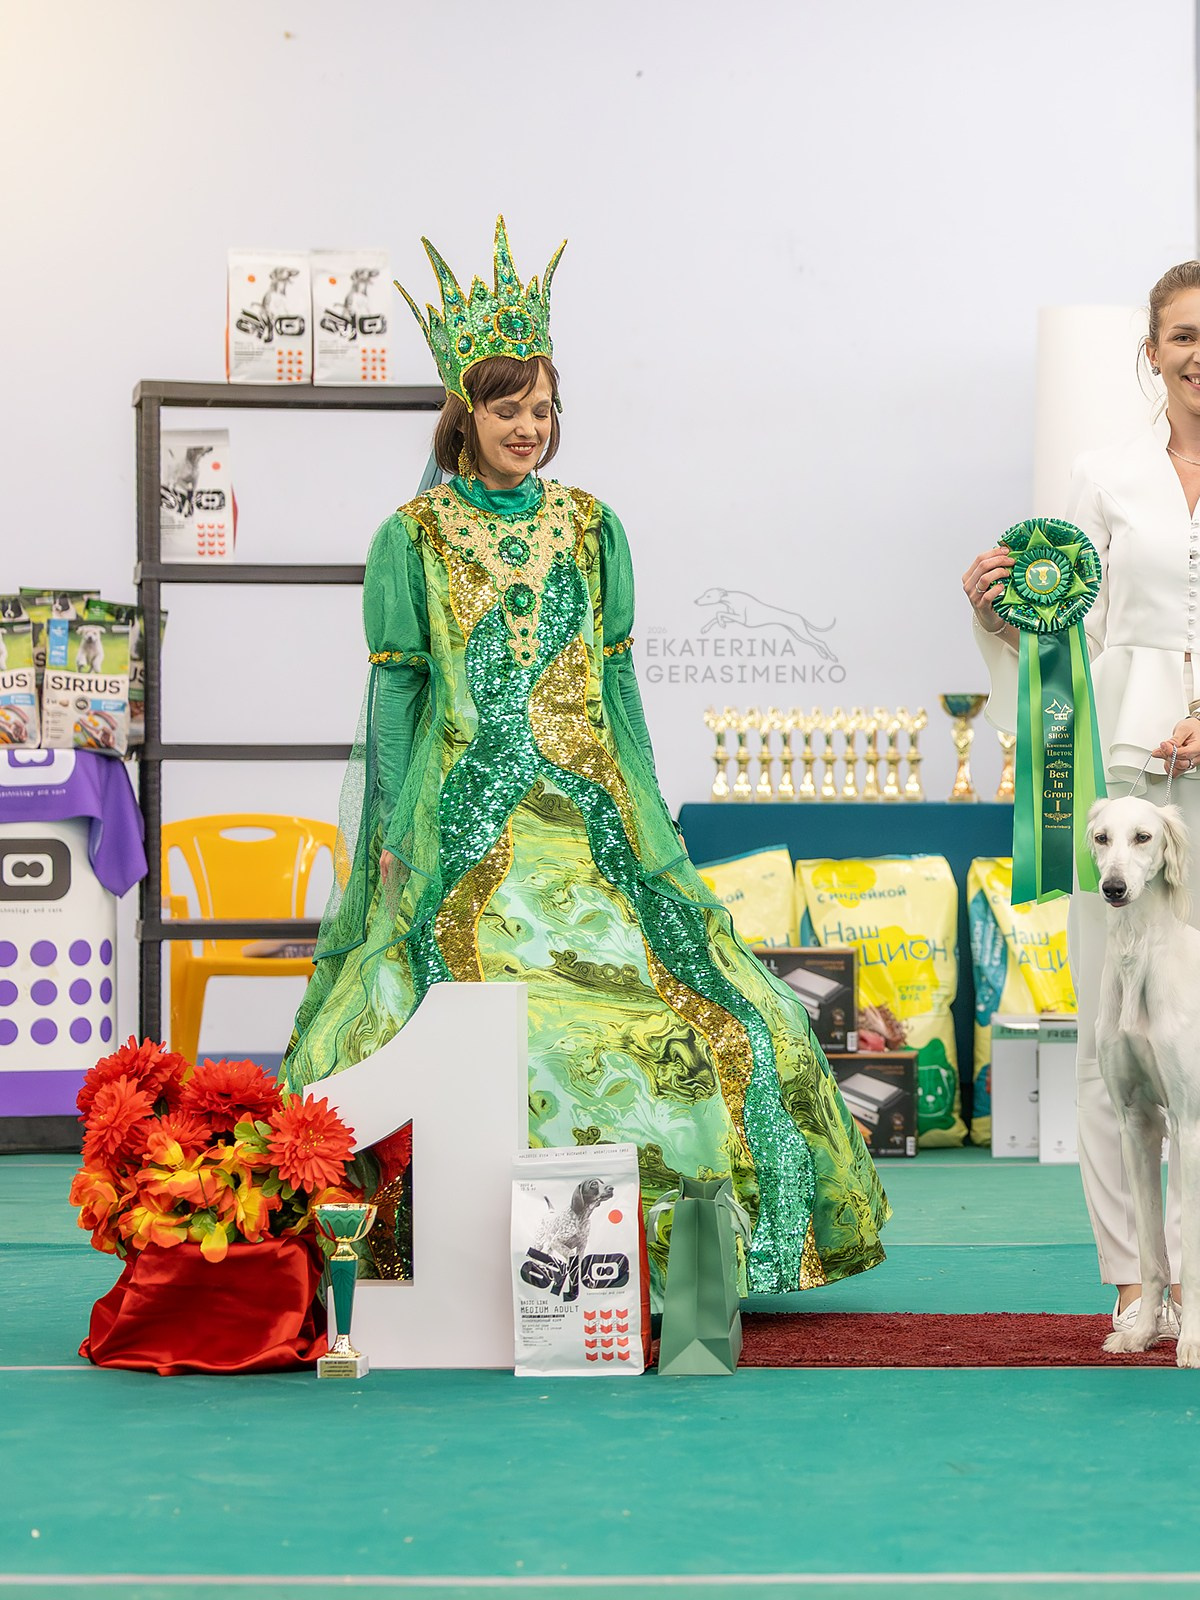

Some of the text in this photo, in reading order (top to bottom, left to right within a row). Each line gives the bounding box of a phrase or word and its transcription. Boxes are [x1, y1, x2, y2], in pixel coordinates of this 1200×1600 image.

[51, 675, 121, 695] SIRIUS
[1049, 770, 1069, 779] Best
[1053, 780, 1063, 789] In
[1043, 790, 1073, 800] Group
[829, 885, 907, 902] индейкой
[823, 921, 880, 945] Наш
[1003, 925, 1050, 946] Наш
[303, 982, 528, 1369] 1
[554, 1305, 579, 1313] ADULT
